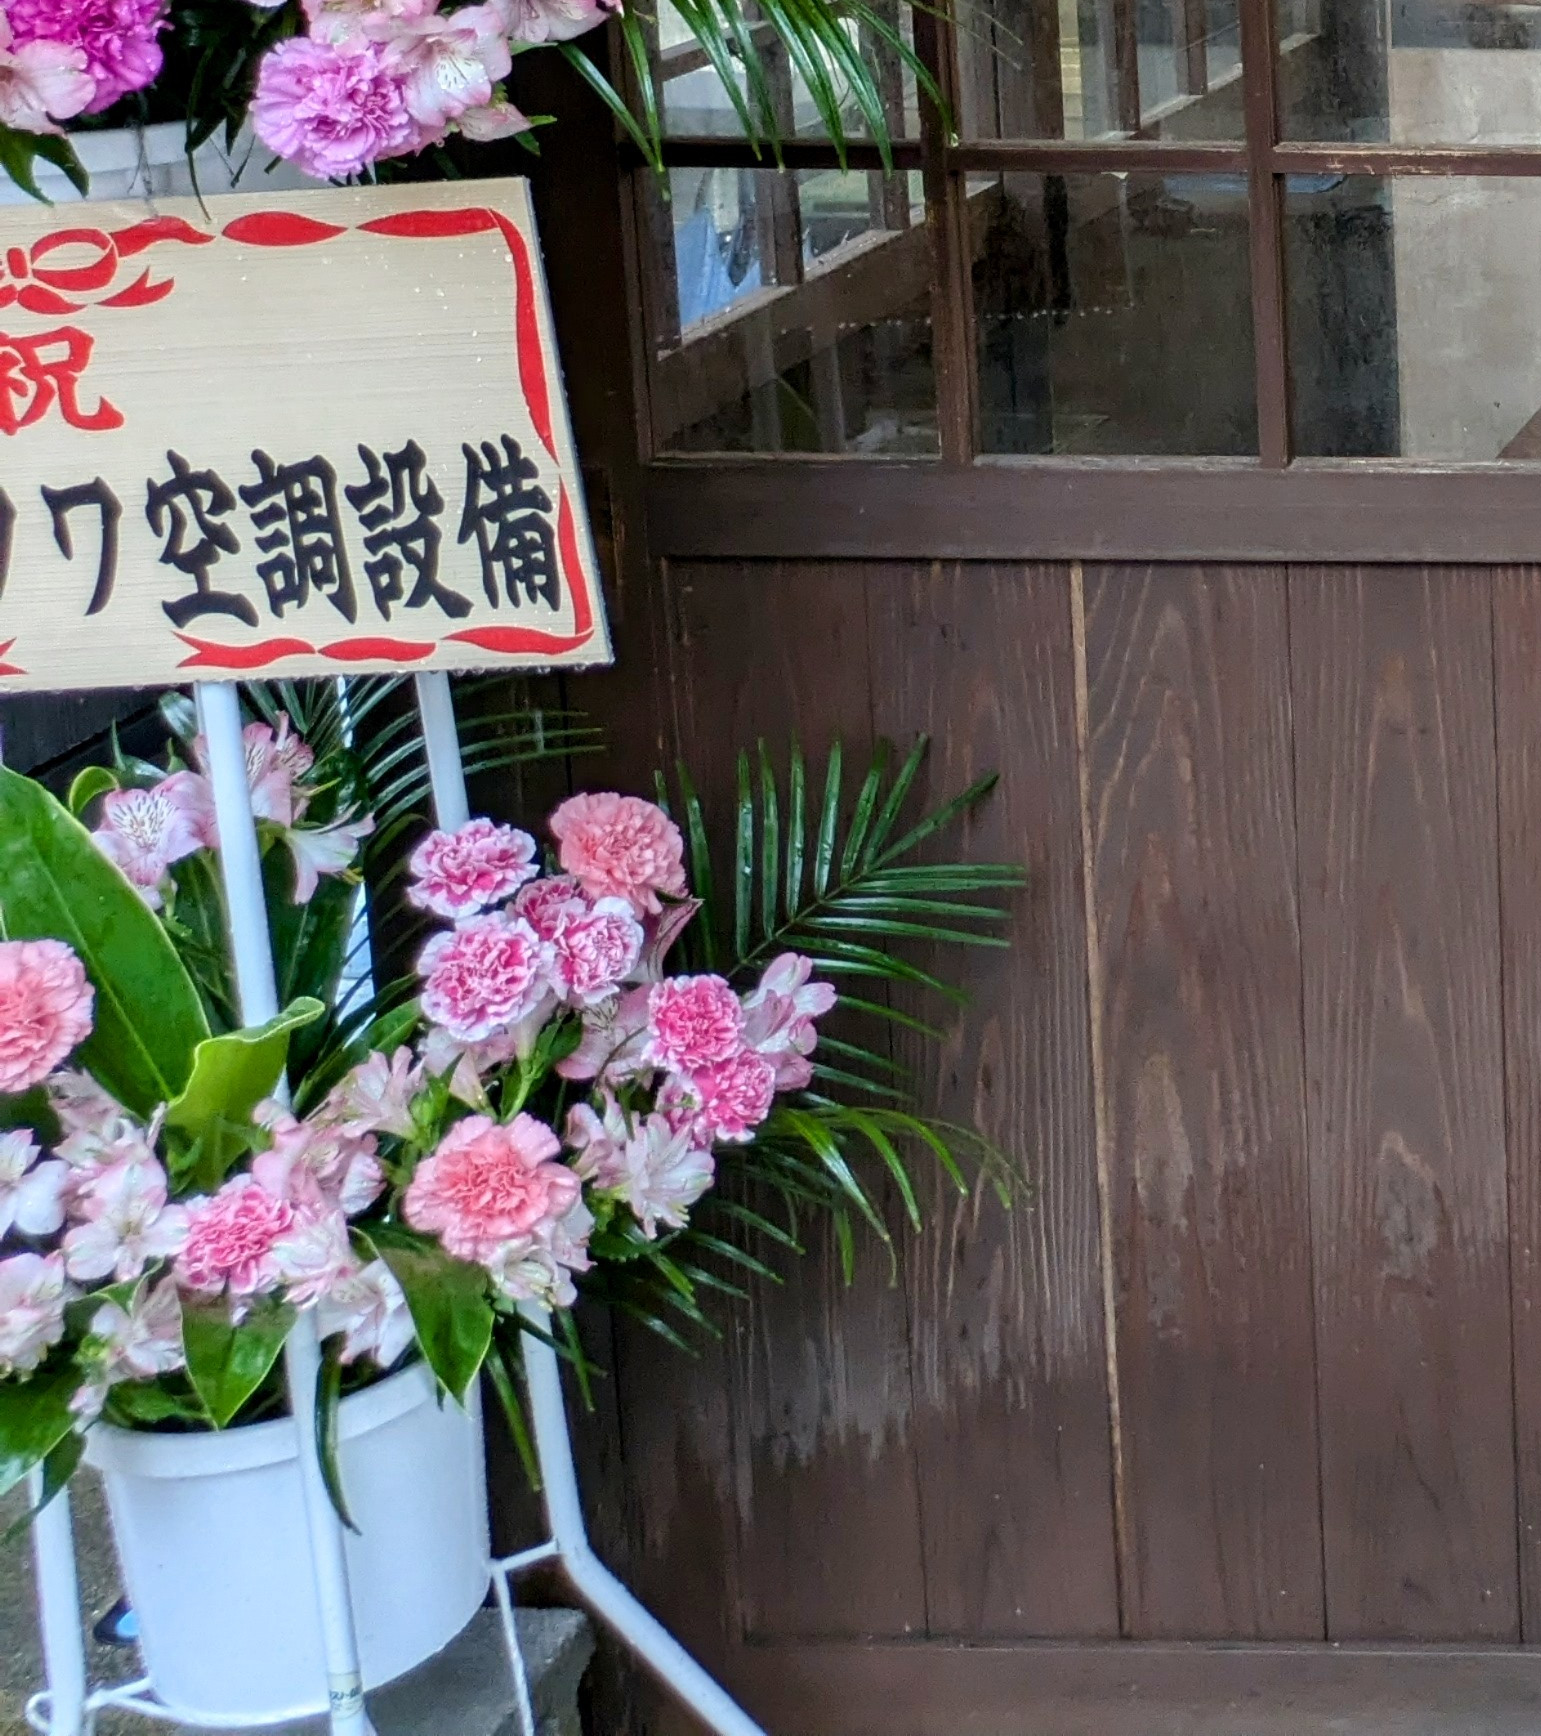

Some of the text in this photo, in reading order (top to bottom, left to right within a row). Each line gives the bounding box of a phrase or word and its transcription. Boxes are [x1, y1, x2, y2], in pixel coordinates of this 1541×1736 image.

[0, 432, 563, 630] ワ空調設備
